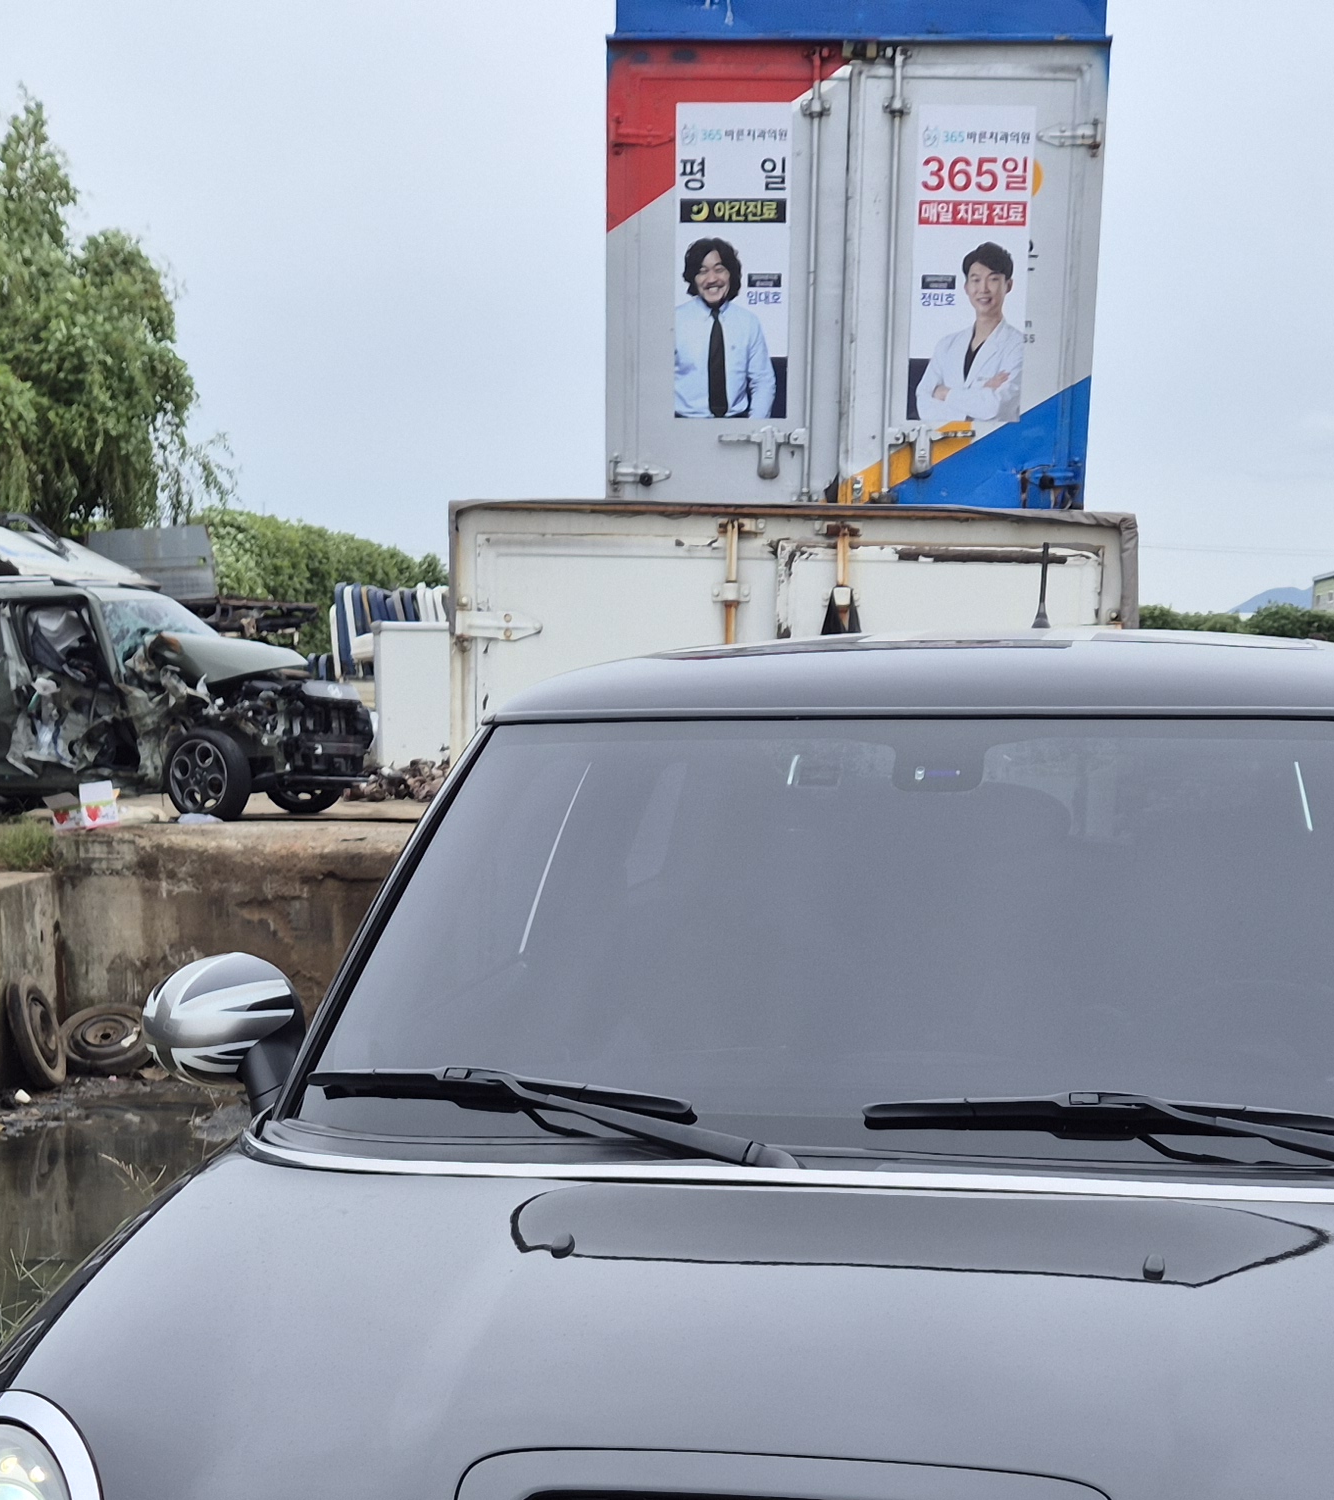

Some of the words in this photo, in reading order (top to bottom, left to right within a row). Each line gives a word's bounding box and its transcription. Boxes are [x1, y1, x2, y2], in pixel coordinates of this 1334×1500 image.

[921, 155, 1028, 192] 365일
[714, 201, 778, 221] 야간진료
[920, 203, 953, 223] 매일
[956, 203, 989, 224] 치과
[992, 203, 1025, 224] 진료
[921, 292, 956, 307] 정민호
